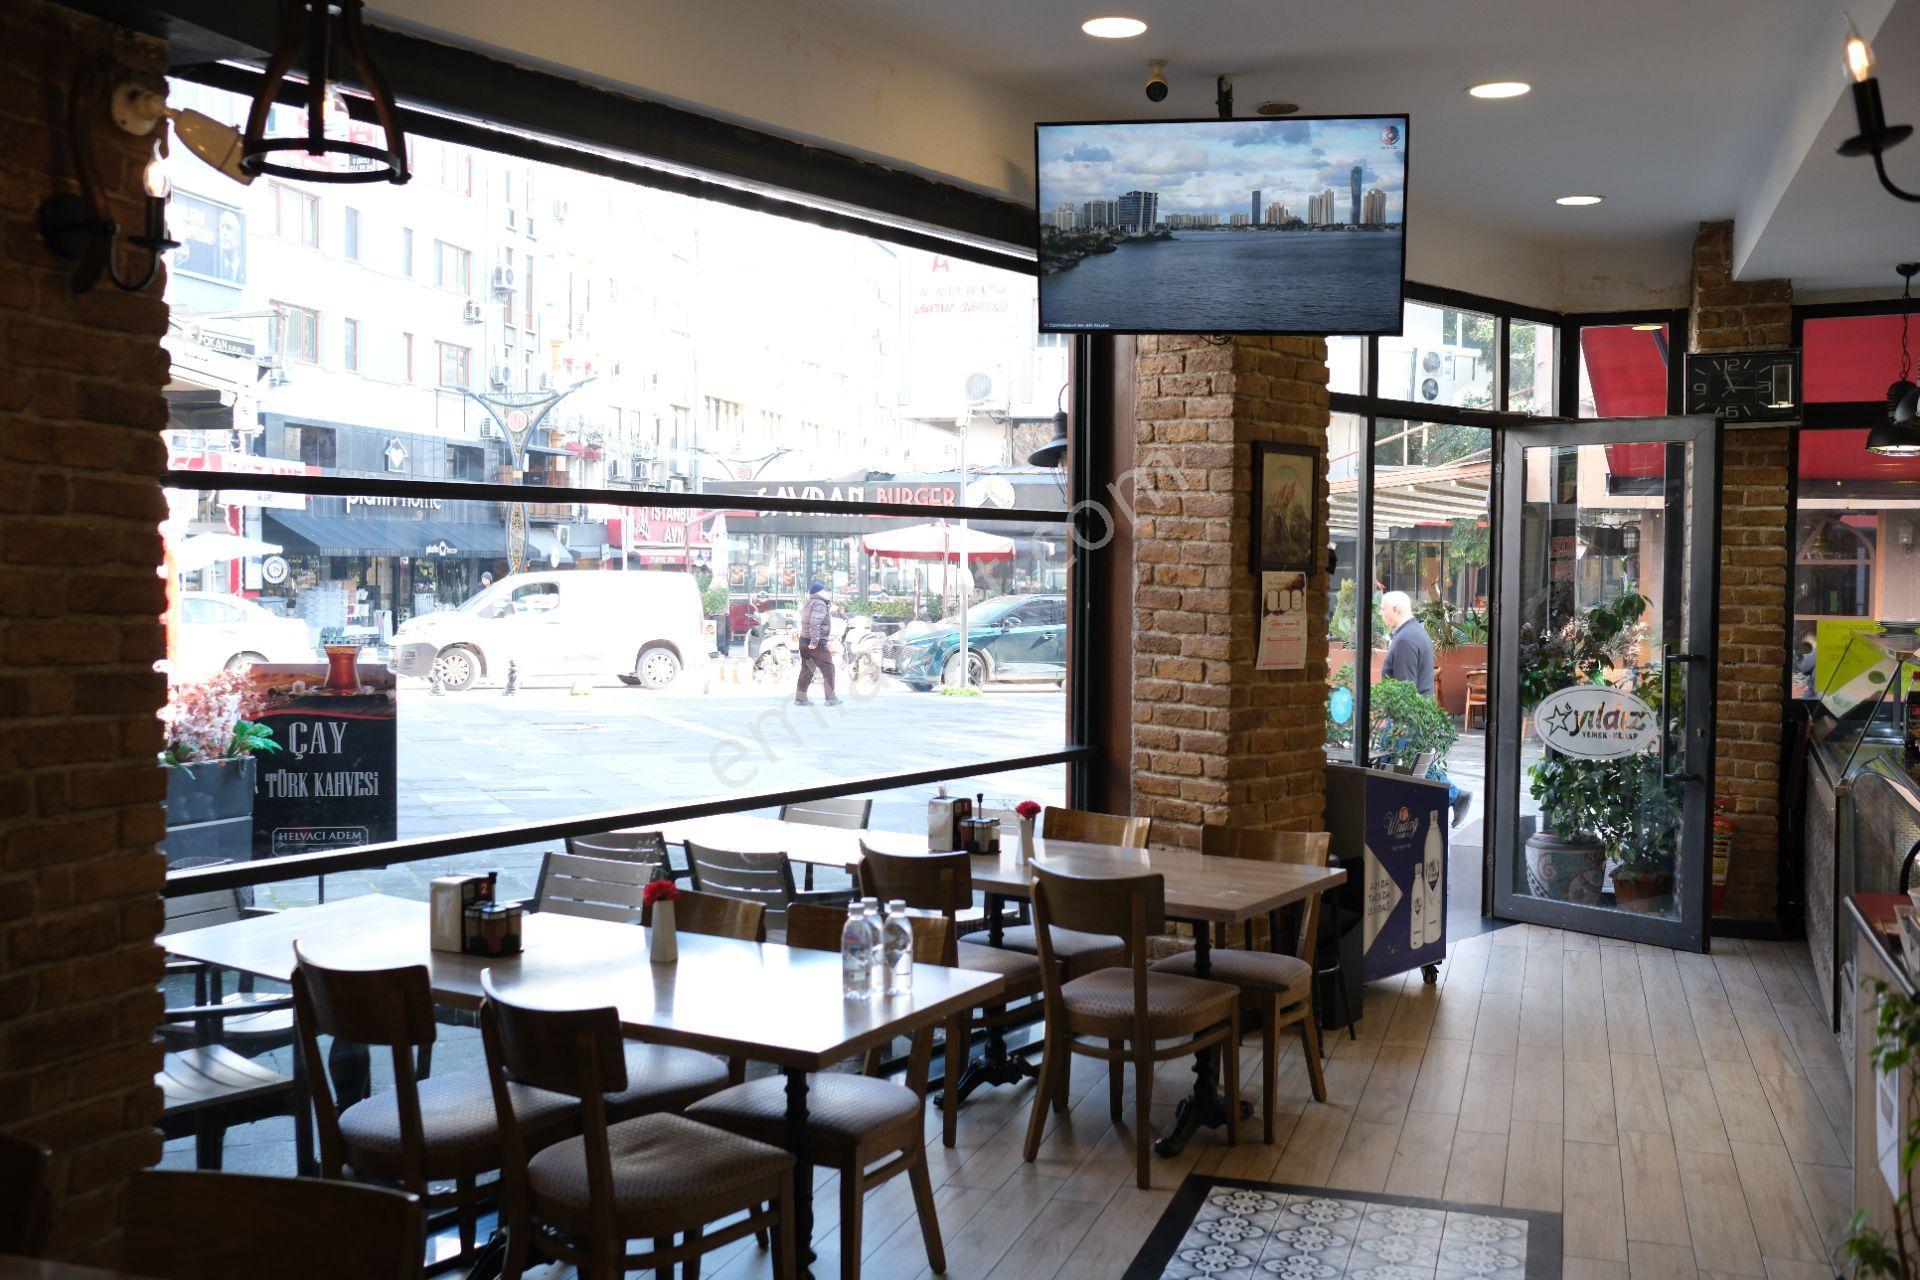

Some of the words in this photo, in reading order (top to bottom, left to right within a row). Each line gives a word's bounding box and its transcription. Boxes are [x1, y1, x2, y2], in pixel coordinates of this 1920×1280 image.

[1725, 358, 1740, 371] 12
[1693, 382, 1707, 395] 9
[1757, 381, 1772, 394] 3
[1726, 405, 1739, 418] 6
[875, 487, 956, 507] BURGER
[289, 721, 348, 760] ÇAY
[1582, 731, 1608, 739] YEMEK
[265, 769, 308, 798] TÜRK
[328, 831, 362, 840] ADEM
